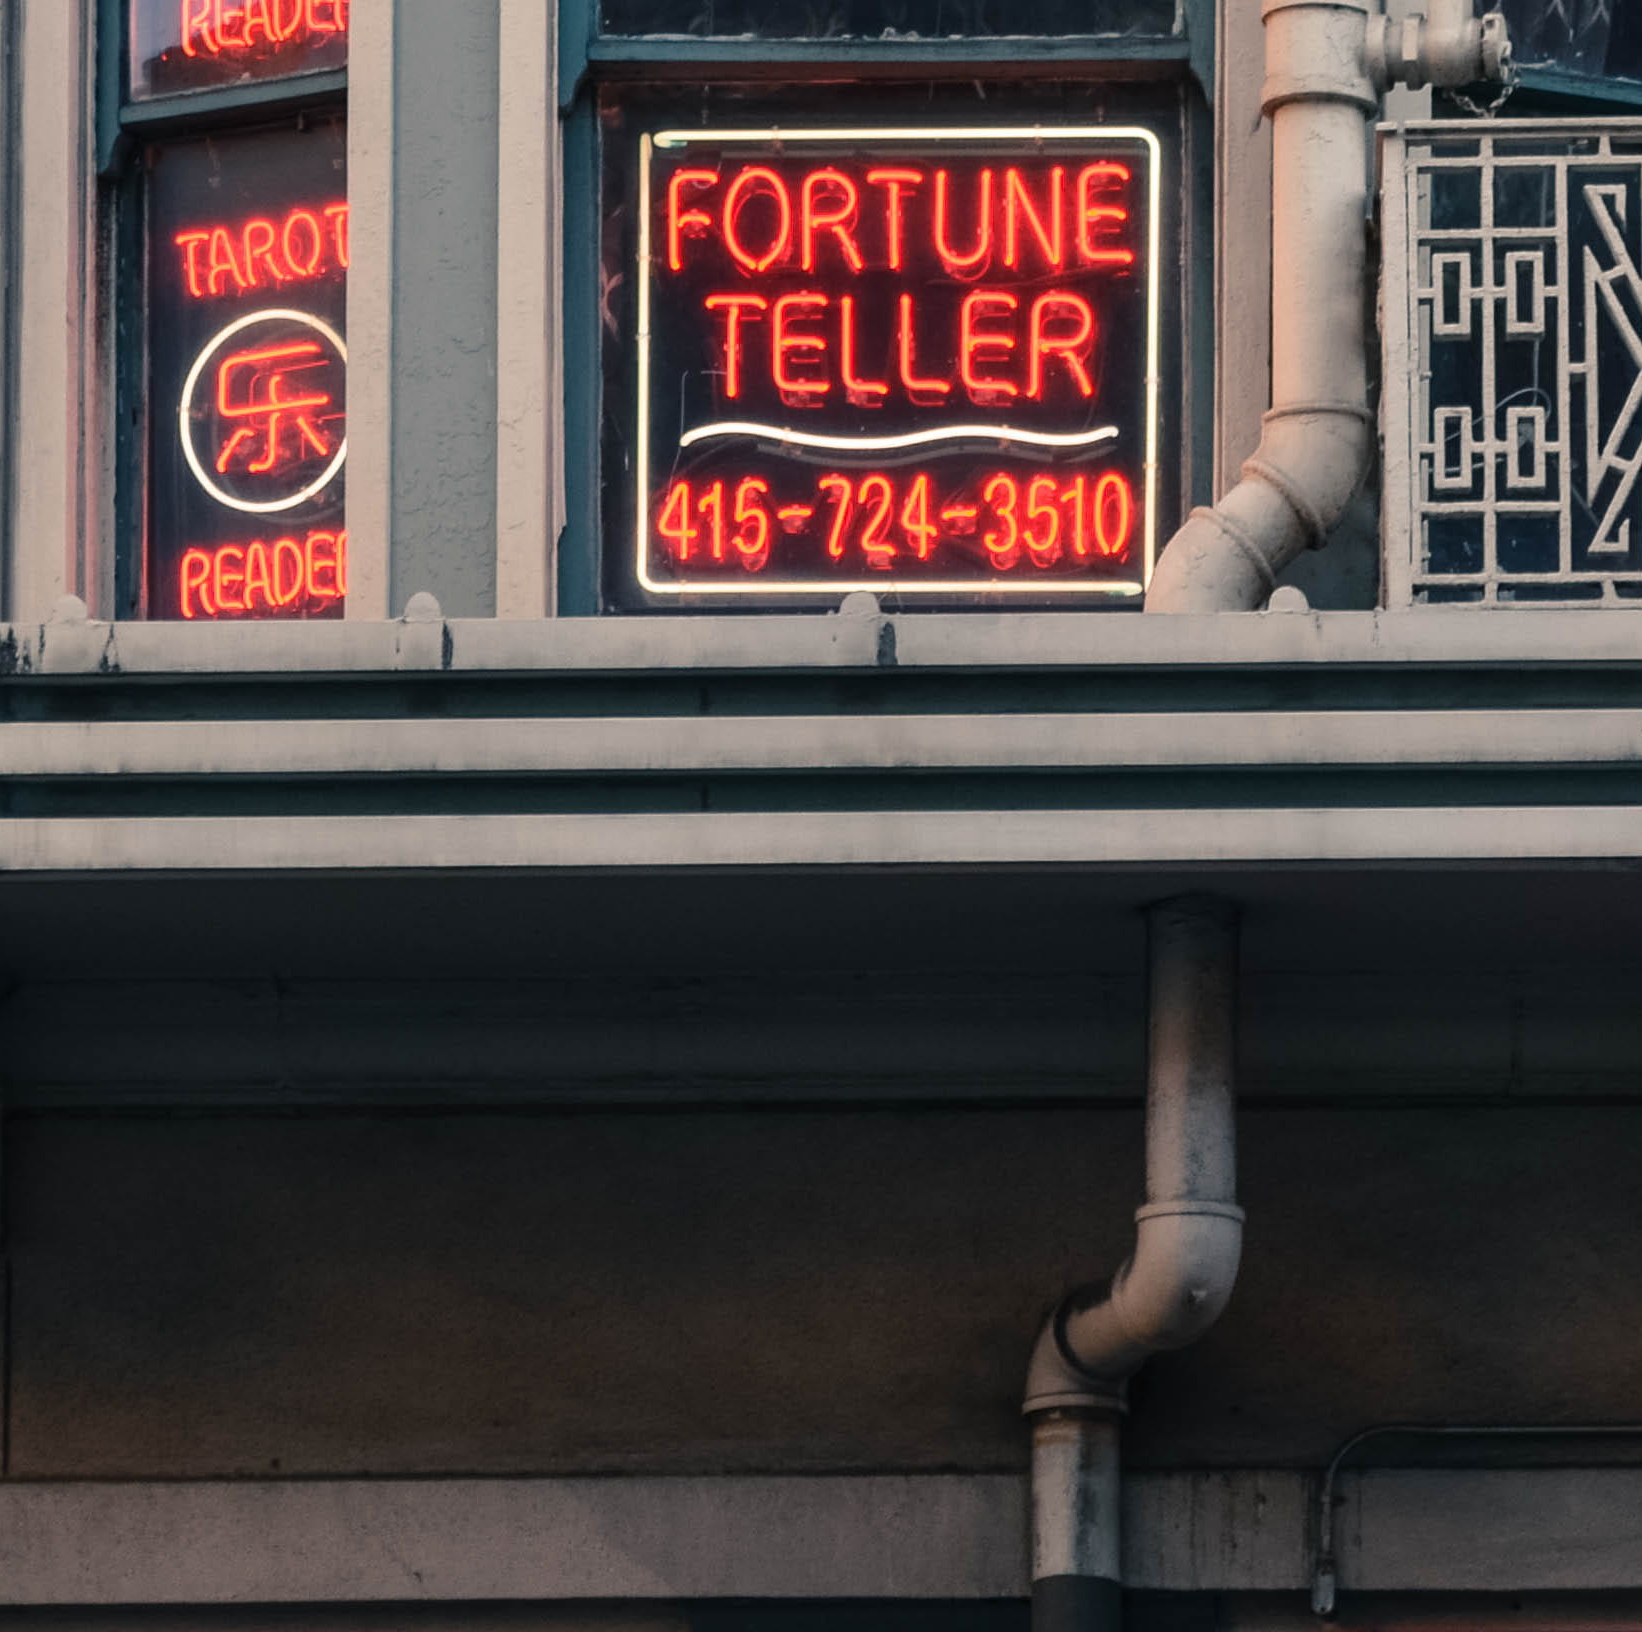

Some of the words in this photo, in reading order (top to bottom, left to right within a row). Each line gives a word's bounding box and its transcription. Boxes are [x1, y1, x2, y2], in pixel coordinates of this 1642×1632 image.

[666, 163, 1135, 272] FORTUNE
[705, 291, 1095, 399] TELLER
[216, 342, 330, 473] 乐
[657, 472, 1133, 561] 415-724-3510
[180, 530, 348, 619] READE
